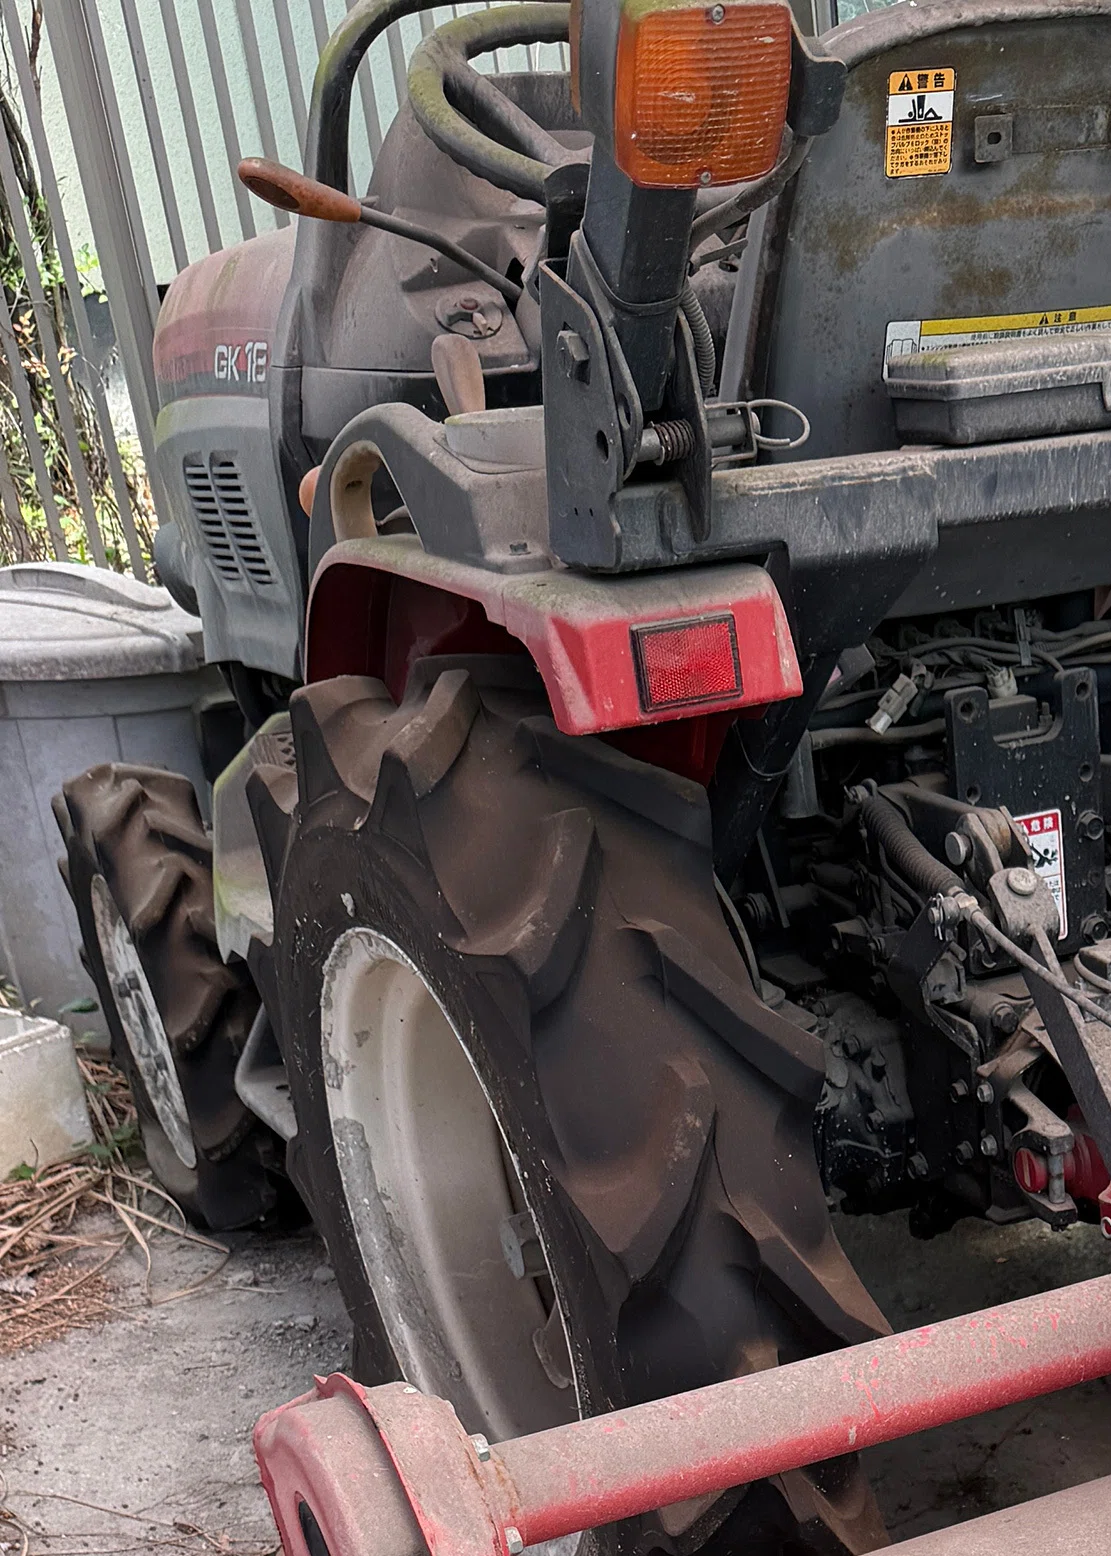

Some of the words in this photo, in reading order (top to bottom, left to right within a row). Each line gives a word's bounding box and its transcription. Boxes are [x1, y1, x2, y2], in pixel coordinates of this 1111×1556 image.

[917, 72, 945, 90] 警告
[1054, 311, 1077, 323] 注意
[1030, 816, 1054, 832] 危険
